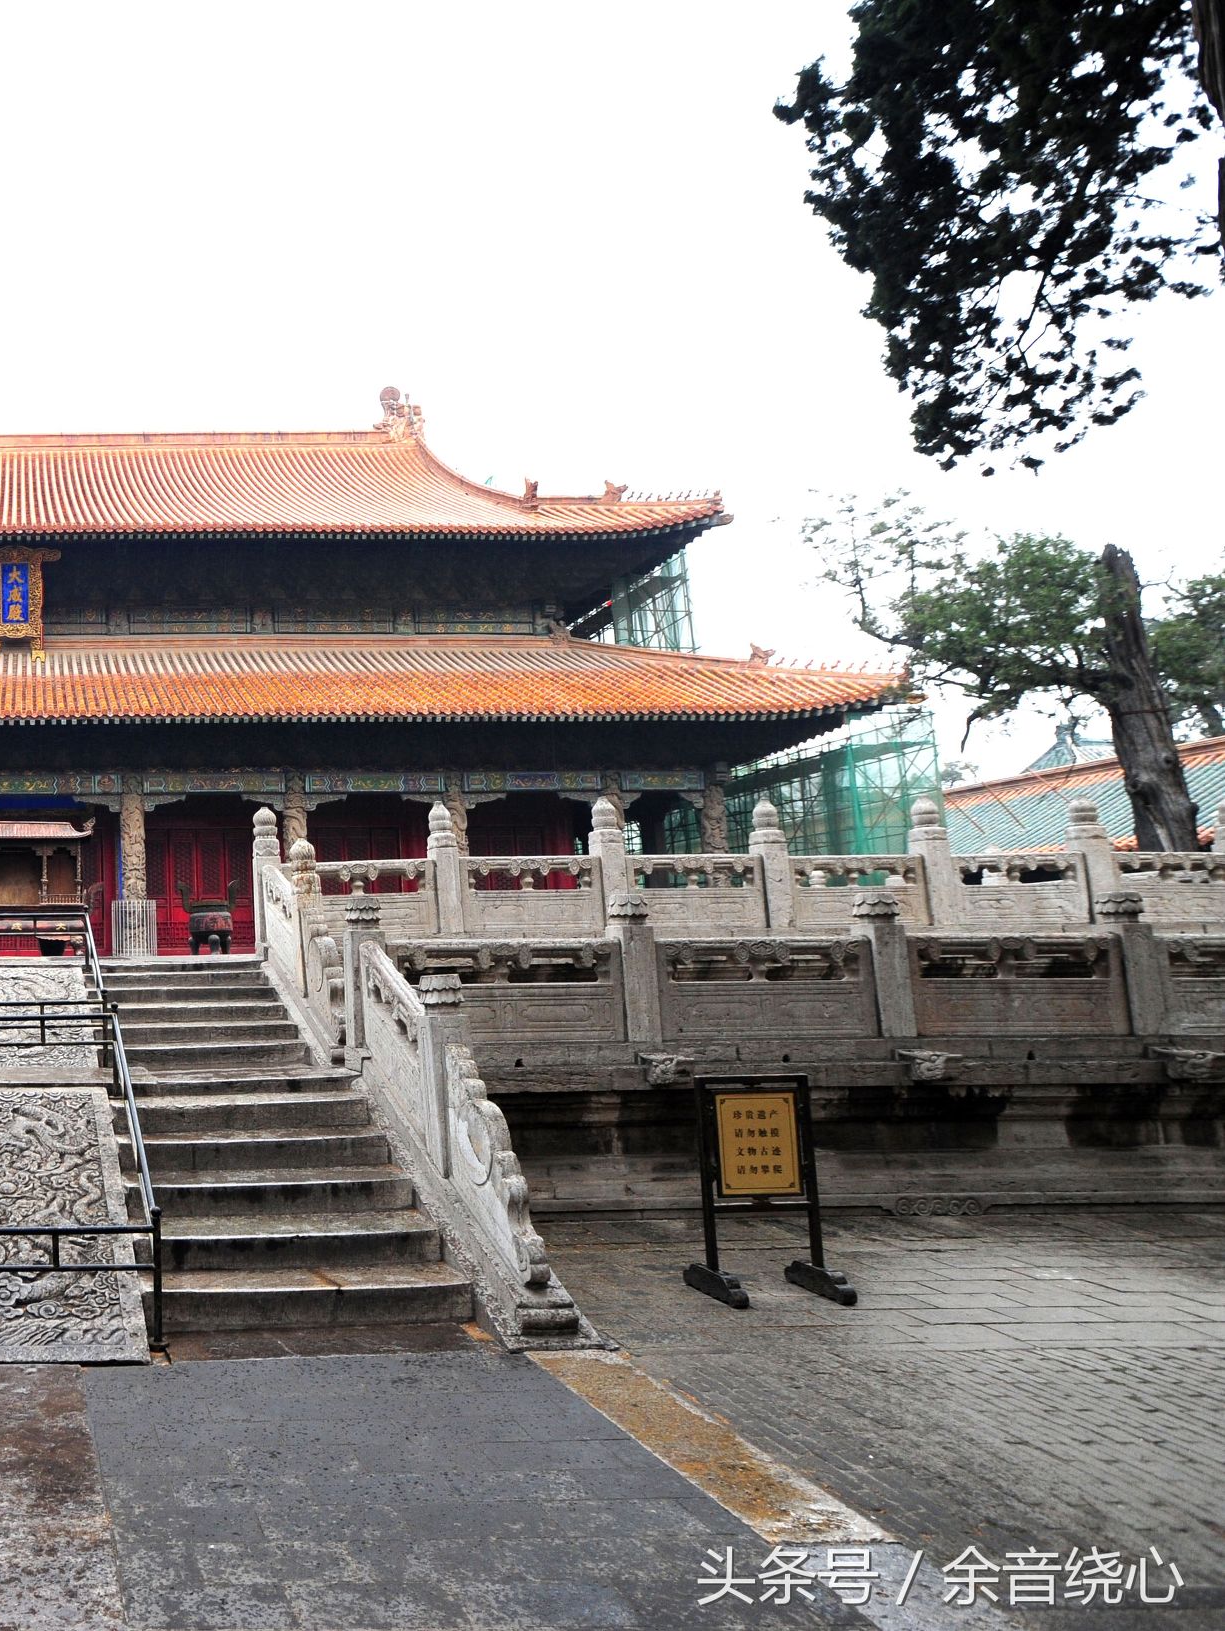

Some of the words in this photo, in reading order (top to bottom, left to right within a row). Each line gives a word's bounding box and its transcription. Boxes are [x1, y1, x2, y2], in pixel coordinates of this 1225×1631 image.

[732, 1109, 779, 1120] 珍贵遗产
[734, 1128, 780, 1138] 请勿触摸
[736, 1146, 782, 1157] 文物古迹
[737, 1164, 783, 1175] 请勿攀爬
